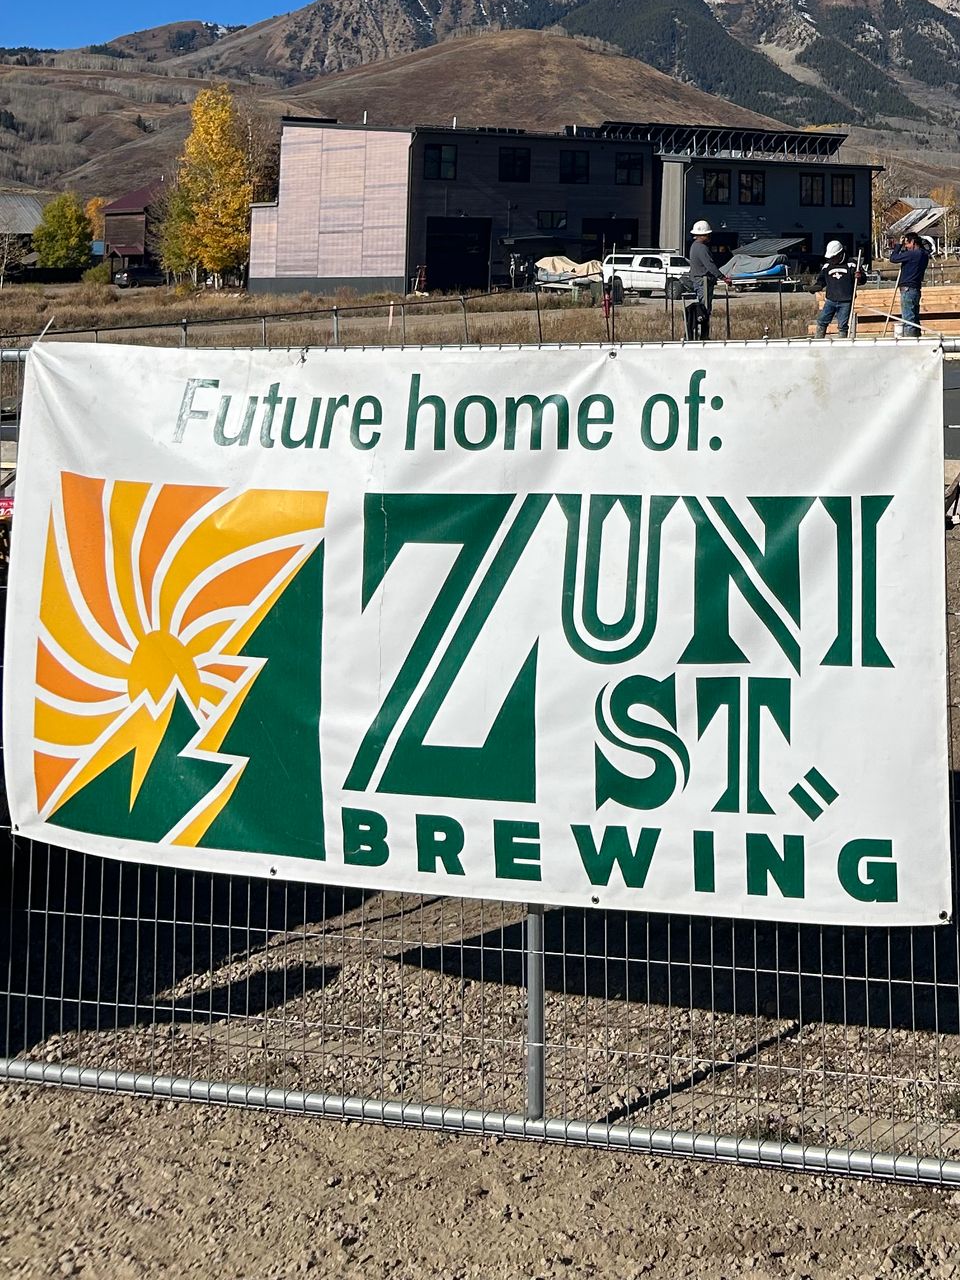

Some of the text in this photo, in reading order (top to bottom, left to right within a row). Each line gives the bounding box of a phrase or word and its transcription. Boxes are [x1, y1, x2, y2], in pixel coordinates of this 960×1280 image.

[174, 370, 723, 452] Future home of:
[342, 493, 893, 803] ZUNI
[342, 806, 898, 903] BREWING
